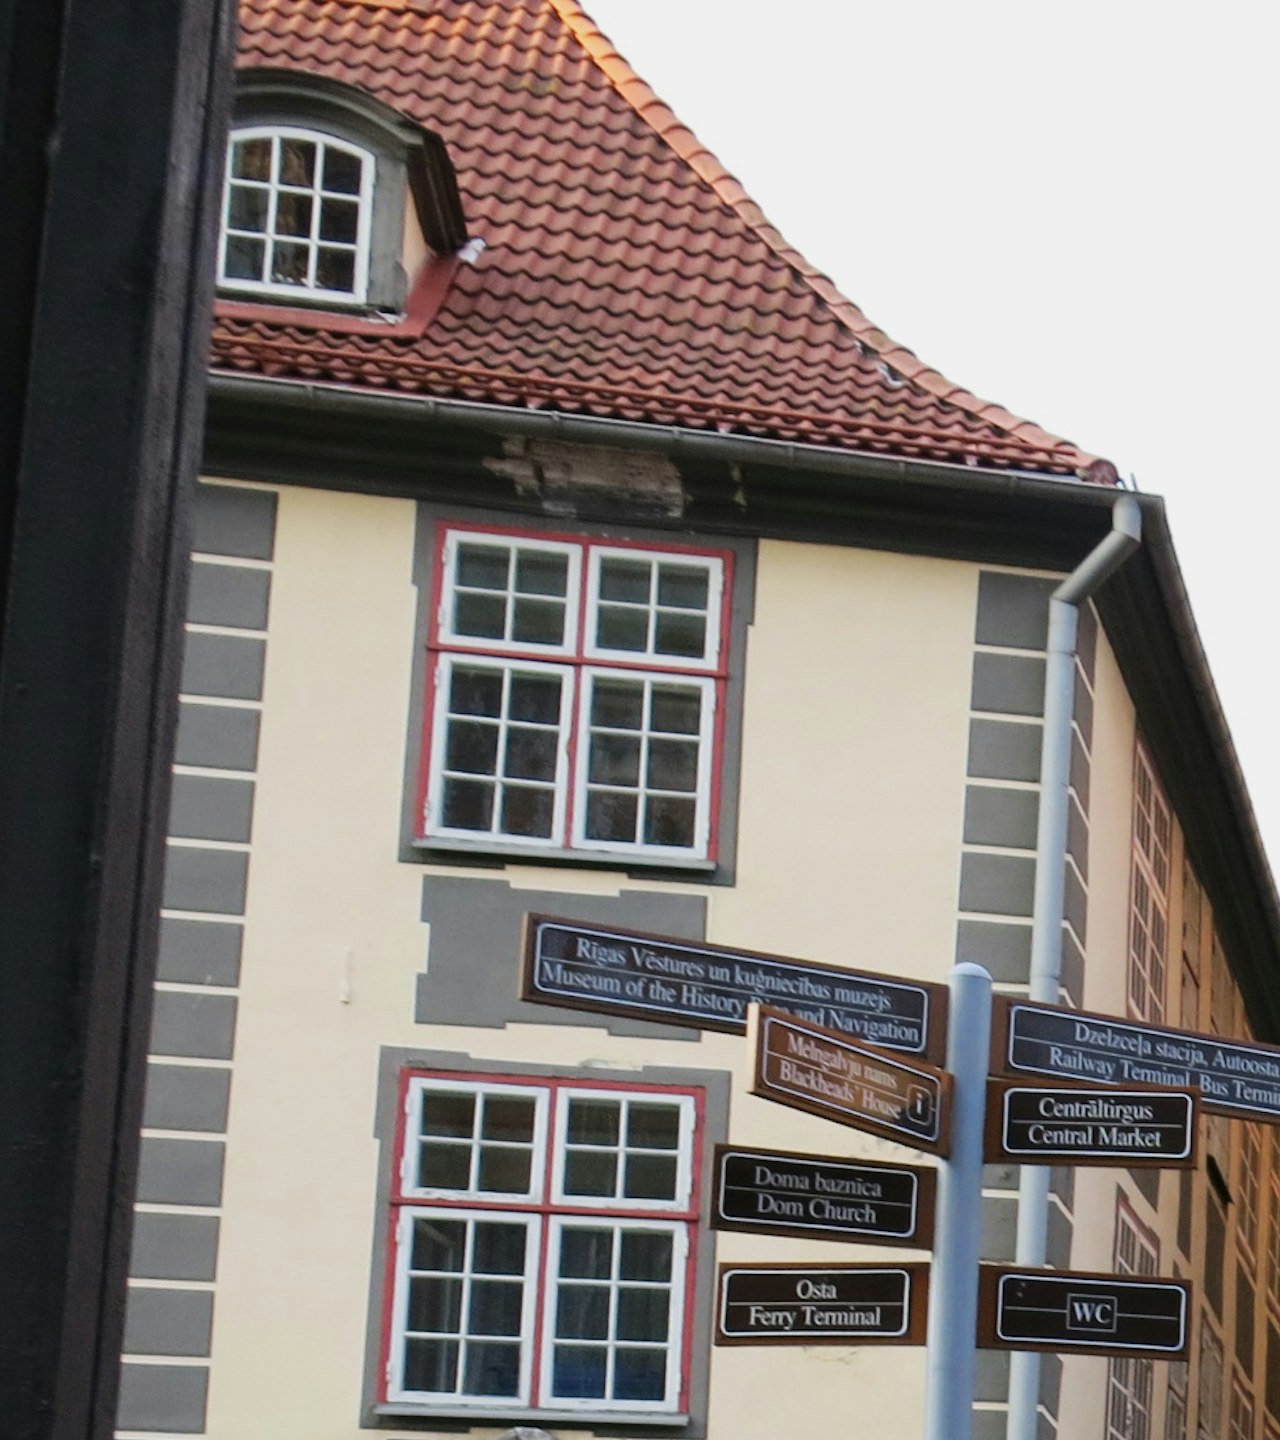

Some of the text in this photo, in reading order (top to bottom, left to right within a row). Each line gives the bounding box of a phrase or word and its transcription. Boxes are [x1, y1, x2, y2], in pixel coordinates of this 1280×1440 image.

[576, 937, 626, 967] Rīgas
[631, 946, 705, 977] Vēstures
[708, 964, 730, 983] un
[835, 985, 892, 1013] muzejs
[542, 961, 621, 994] Museum
[625, 976, 648, 998] of
[650, 980, 677, 1003] the
[681, 984, 744, 1019] History
[829, 1009, 920, 1042] Navigation
[1074, 1022, 1152, 1056] Dzelzceļa
[1212, 1051, 1280, 1078] Autoosta
[863, 1065, 898, 1088] nams
[1049, 1046, 1116, 1080] Railway
[1200, 1074, 1229, 1096] Bus
[862, 1087, 902, 1119] House
[1039, 1097, 1154, 1125] Centrāltirgus
[1028, 1124, 1162, 1148] Central Market
[755, 1166, 883, 1198] Doma baznīca
[757, 1193, 877, 1224] Dom Church
[796, 1279, 837, 1299] Osta
[749, 1306, 881, 1330] Ferry Terminal
[1073, 1302, 1112, 1324] WC
